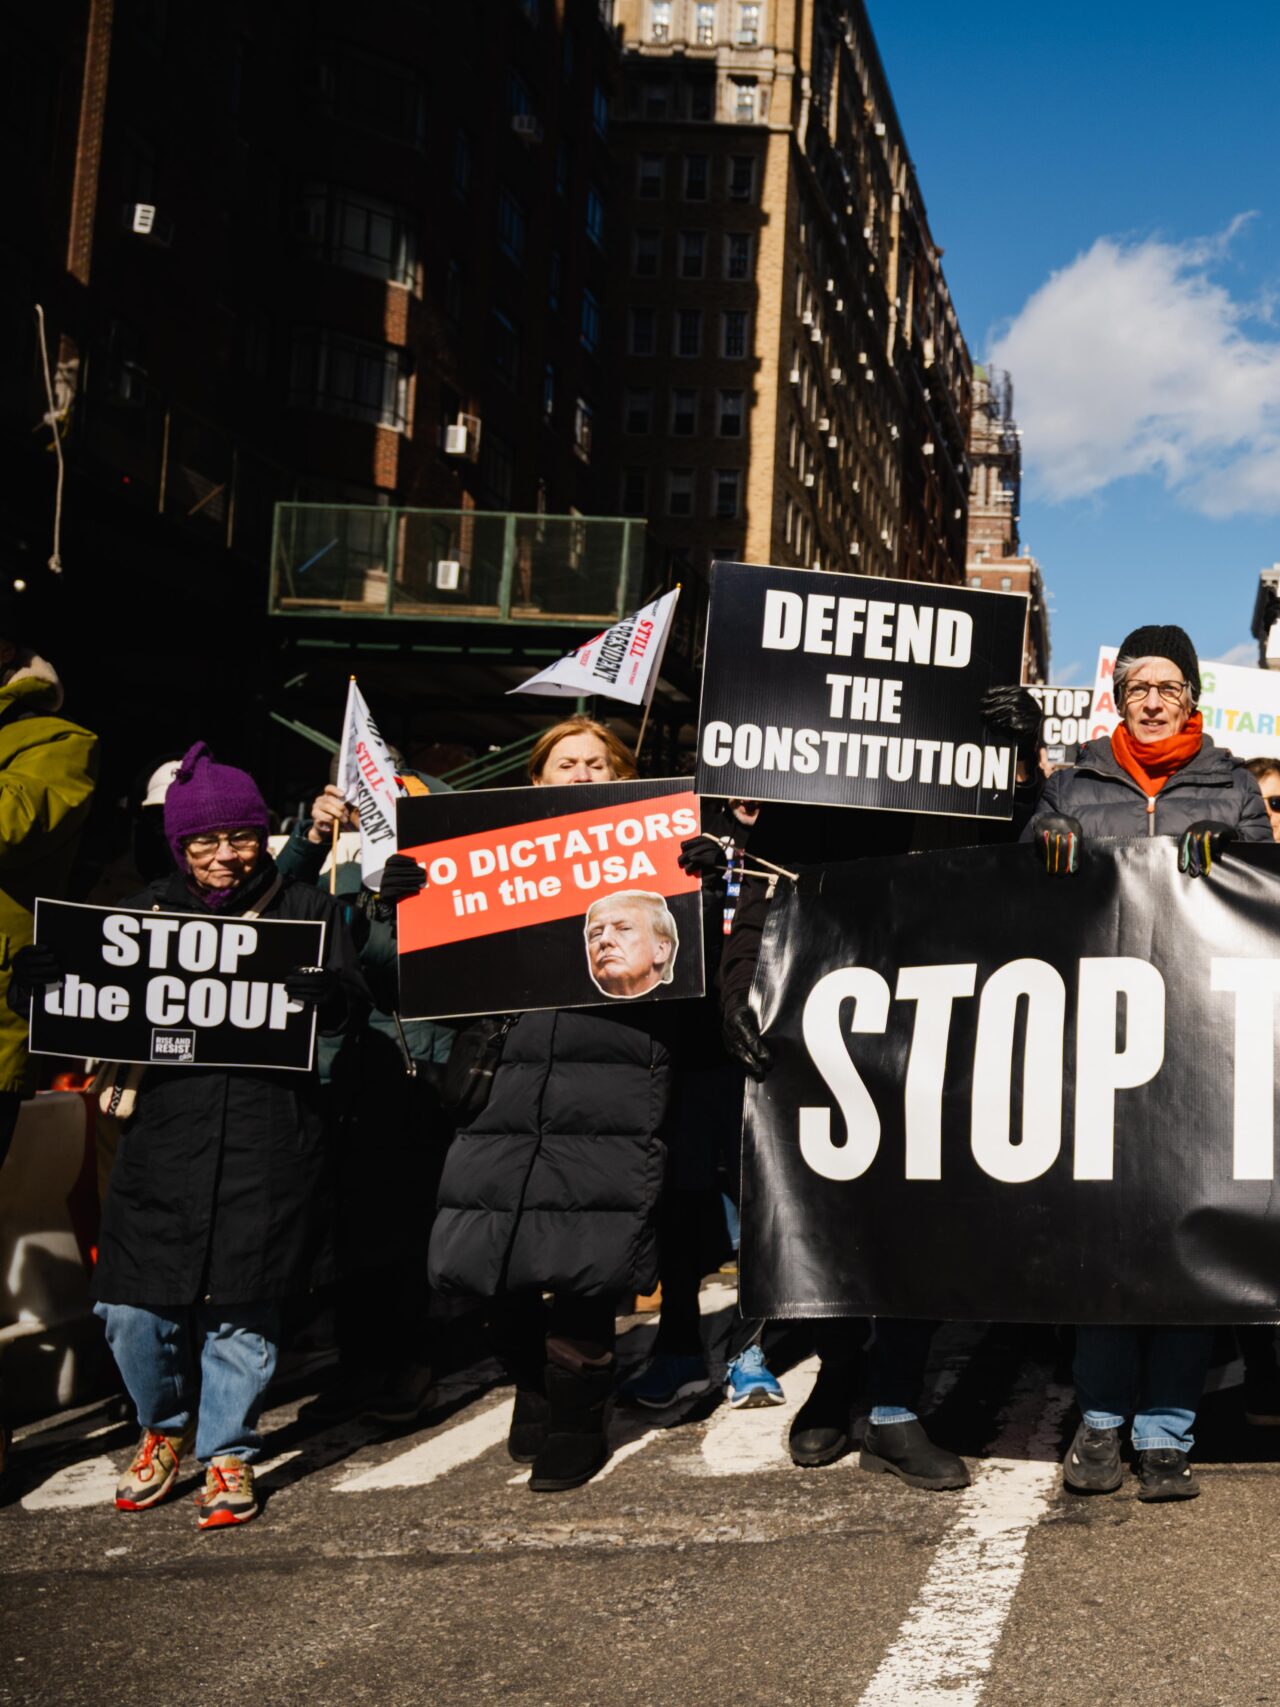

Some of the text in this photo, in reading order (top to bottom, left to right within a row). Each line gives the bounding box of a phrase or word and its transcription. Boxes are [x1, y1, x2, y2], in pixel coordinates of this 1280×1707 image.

[629, 619, 654, 658] STILL
[761, 589, 973, 668] DEFEND
[826, 673, 903, 724] THE
[356, 742, 384, 791] STILL
[702, 721, 1010, 790] CONSTITUTION
[418, 808, 697, 888] O DICTATORS
[452, 851, 657, 917] in the USA
[102, 914, 258, 973] STOP
[45, 974, 130, 1022] the
[155, 1044, 190, 1054] RESIST
[799, 956, 1166, 1183] STOP
